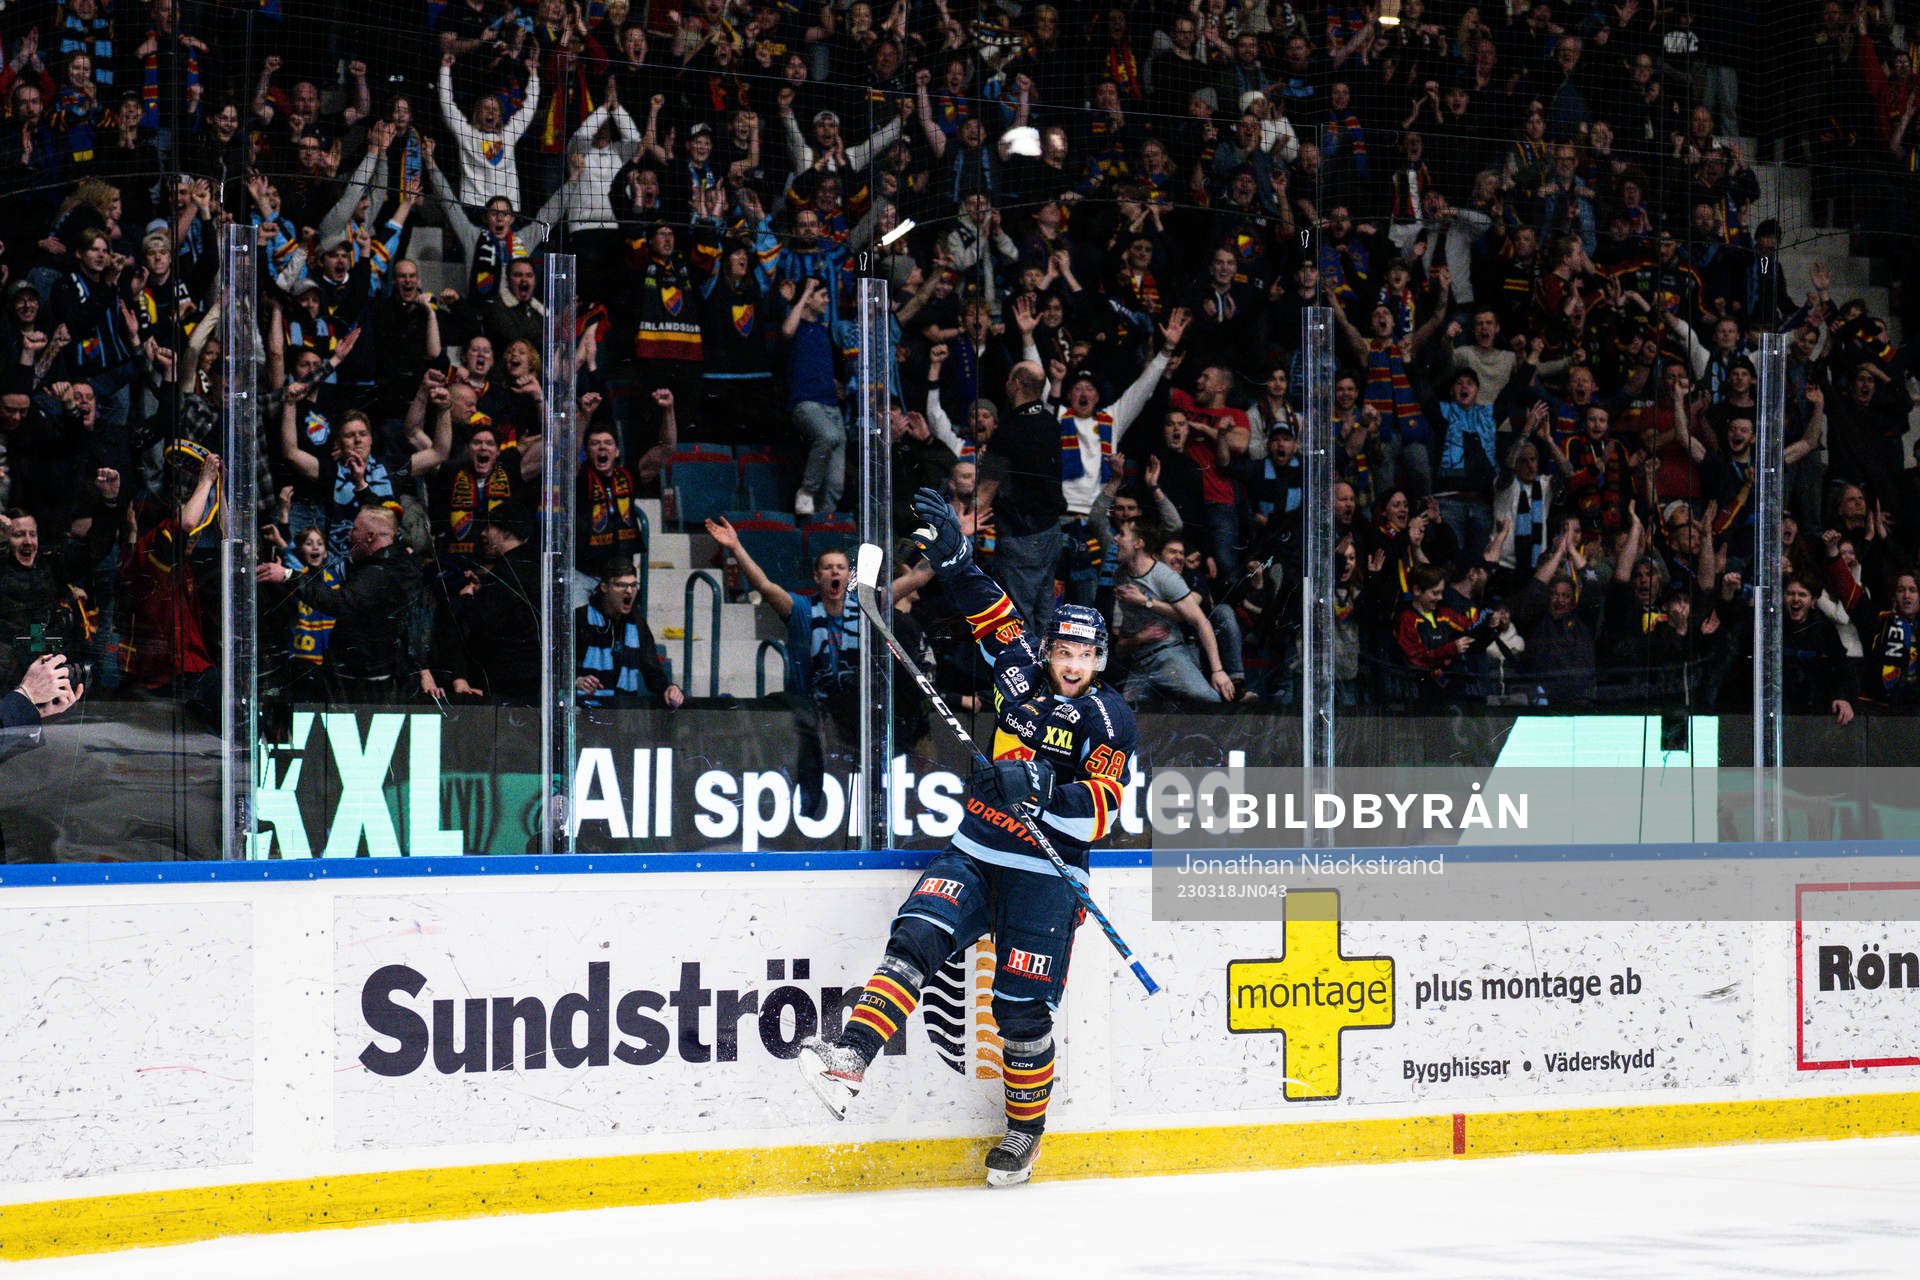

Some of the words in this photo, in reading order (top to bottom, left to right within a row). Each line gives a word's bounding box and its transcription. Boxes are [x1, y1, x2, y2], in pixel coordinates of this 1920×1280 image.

[1005, 666, 1030, 694] B2B
[916, 674, 971, 740] CCM
[1005, 713, 1034, 738] Fabege
[1043, 726, 1073, 750] XXL
[1085, 744, 1126, 779] 58
[565, 747, 672, 838] All
[1819, 943, 1920, 992] Rön
[1238, 976, 1388, 1013] montage
[1416, 974, 1472, 1008] plus
[1481, 970, 1601, 1004] montage
[1610, 967, 1642, 996] ab
[1403, 1056, 1510, 1084] Bygghissar
[1544, 1048, 1656, 1074] Väderskydd
[1005, 1089, 1047, 1101] ordicpm
